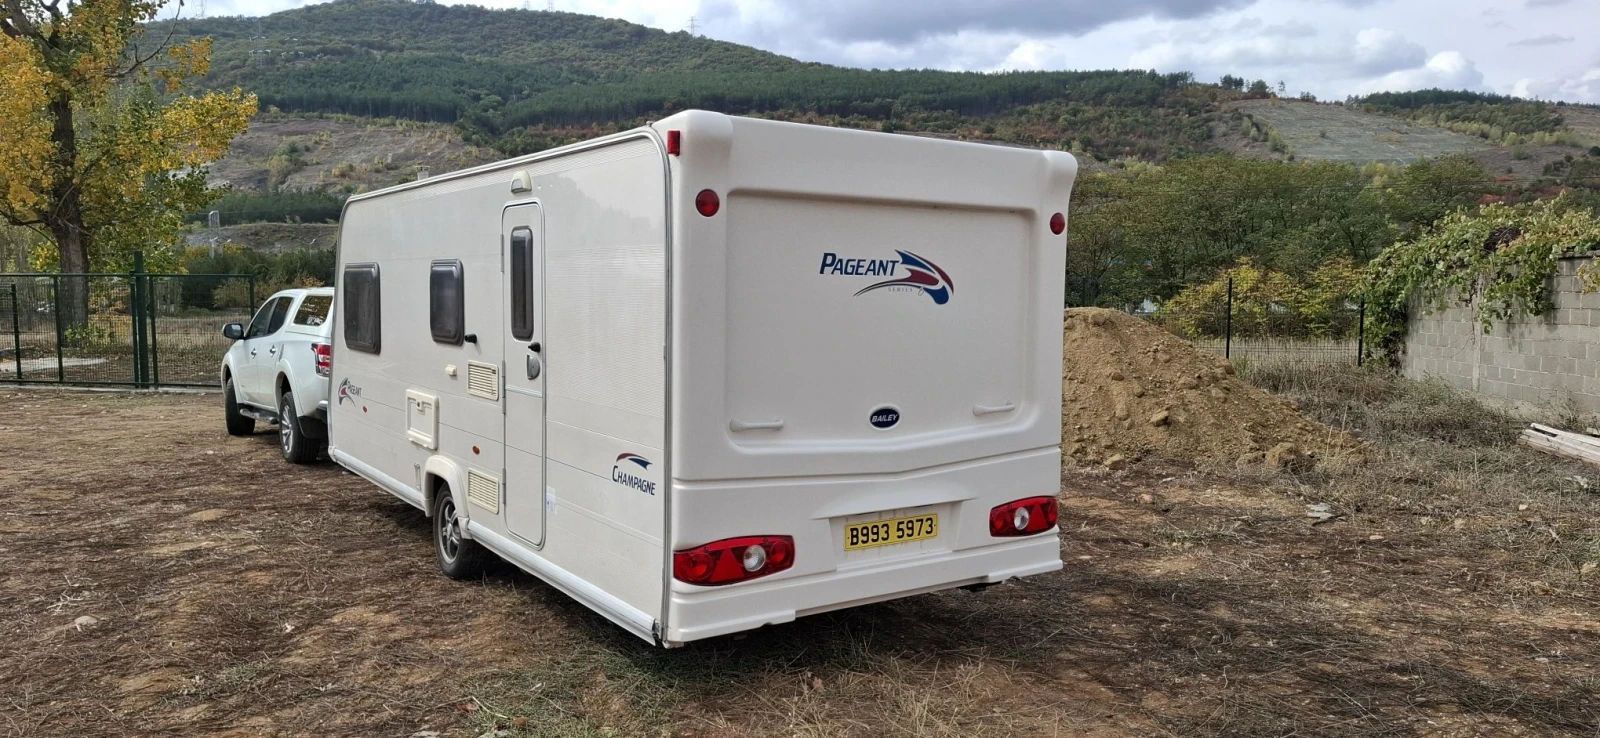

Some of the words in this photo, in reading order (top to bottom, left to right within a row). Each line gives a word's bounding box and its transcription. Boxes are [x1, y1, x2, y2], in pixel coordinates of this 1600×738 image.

[819, 252, 899, 276] PAGEANT
[871, 414, 898, 423] BAILEY
[612, 465, 656, 496] CHAMPAGNE
[849, 523, 890, 546] B993
[896, 517, 934, 539] 5973
